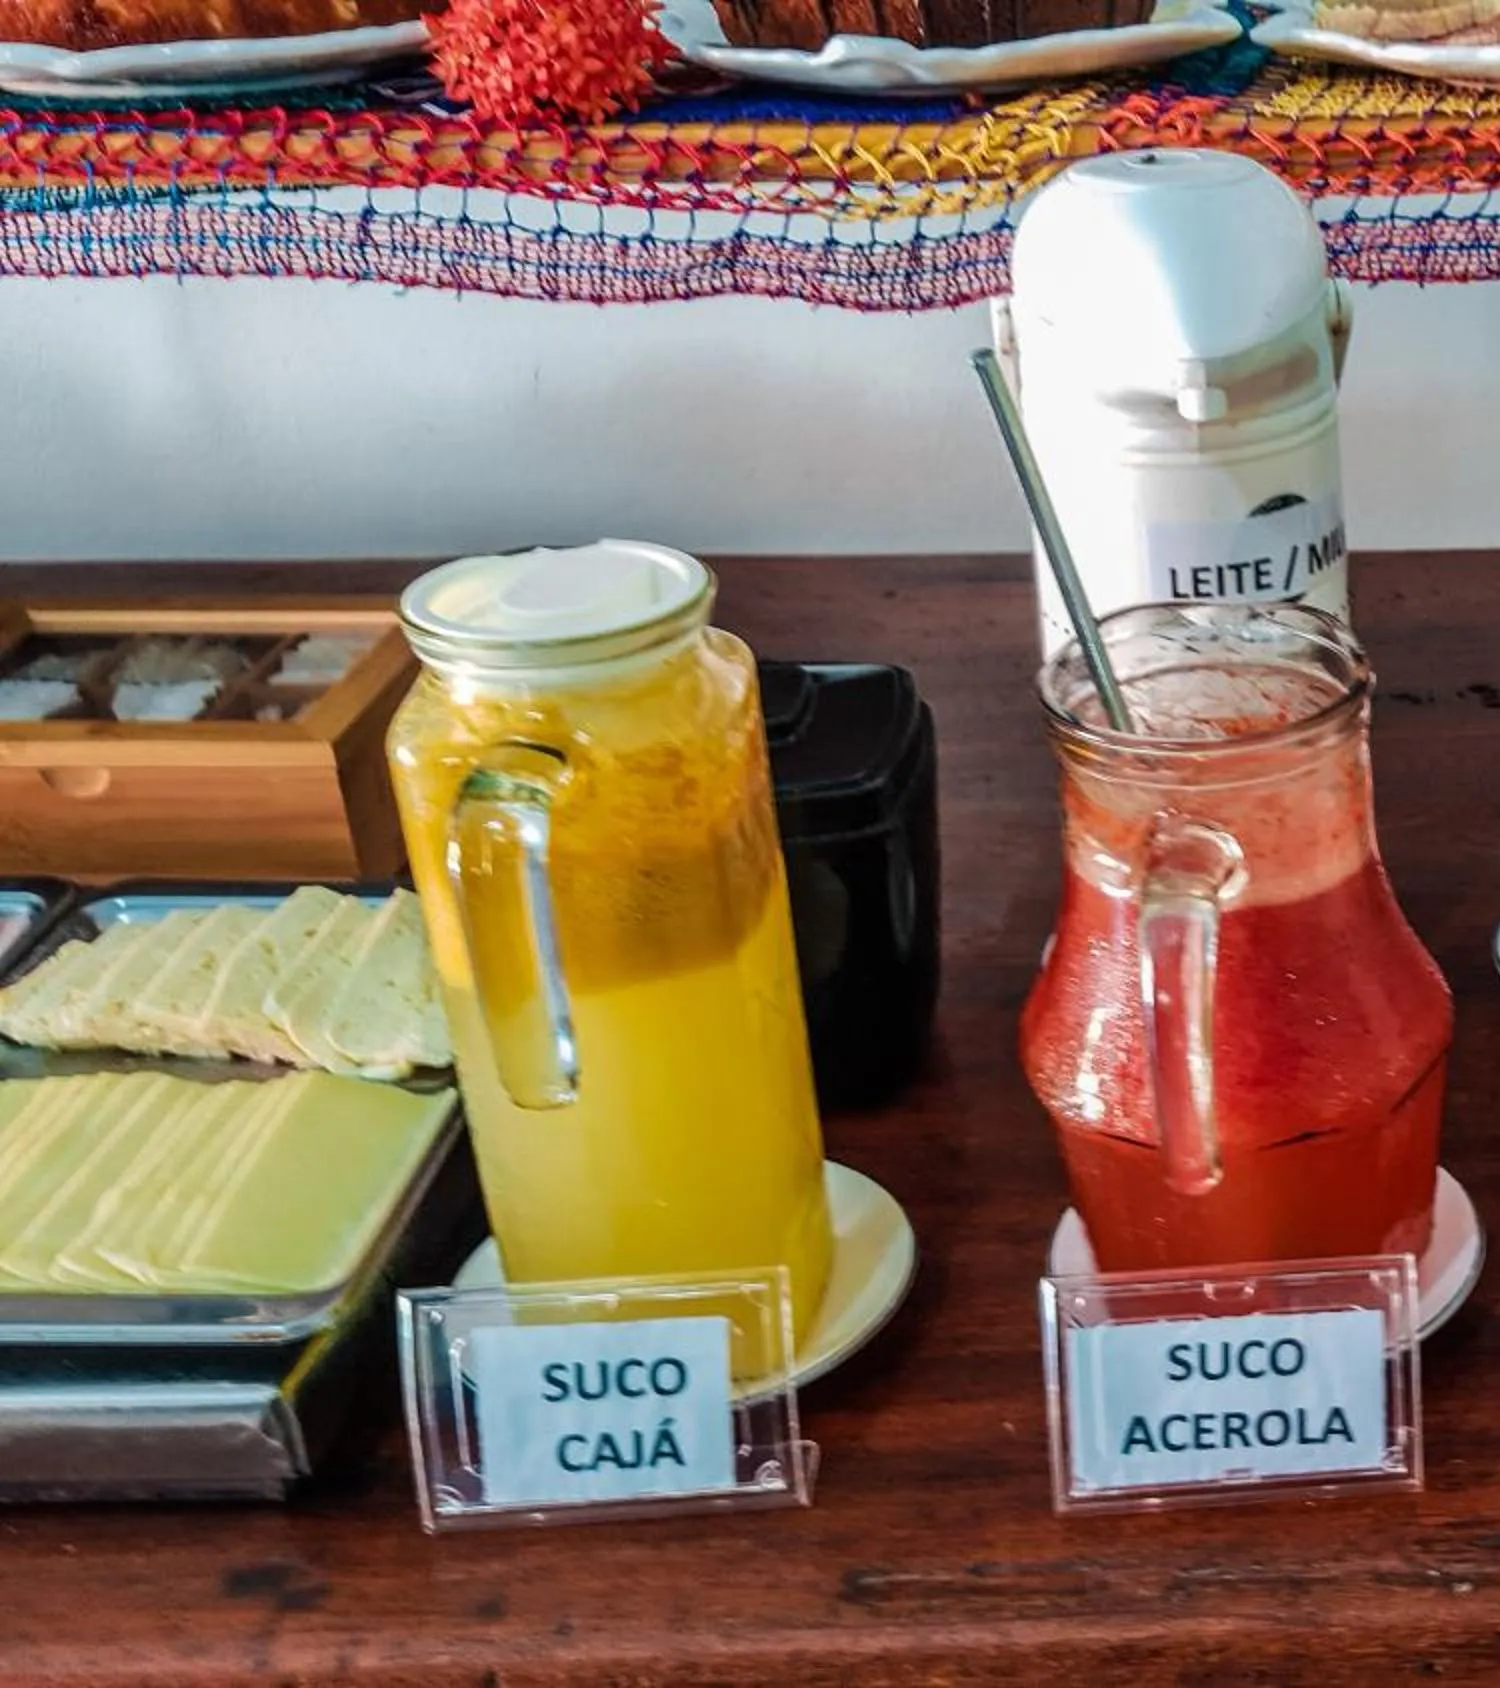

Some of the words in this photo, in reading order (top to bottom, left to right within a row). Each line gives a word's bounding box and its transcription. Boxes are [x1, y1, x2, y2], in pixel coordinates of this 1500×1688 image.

[1169, 557, 1273, 599] LEITE
[542, 1357, 687, 1403] SUCO
[1168, 1337, 1306, 1382] SUCO
[556, 1418, 687, 1472] CAJÁ
[1121, 1406, 1354, 1456] ACEROLA
